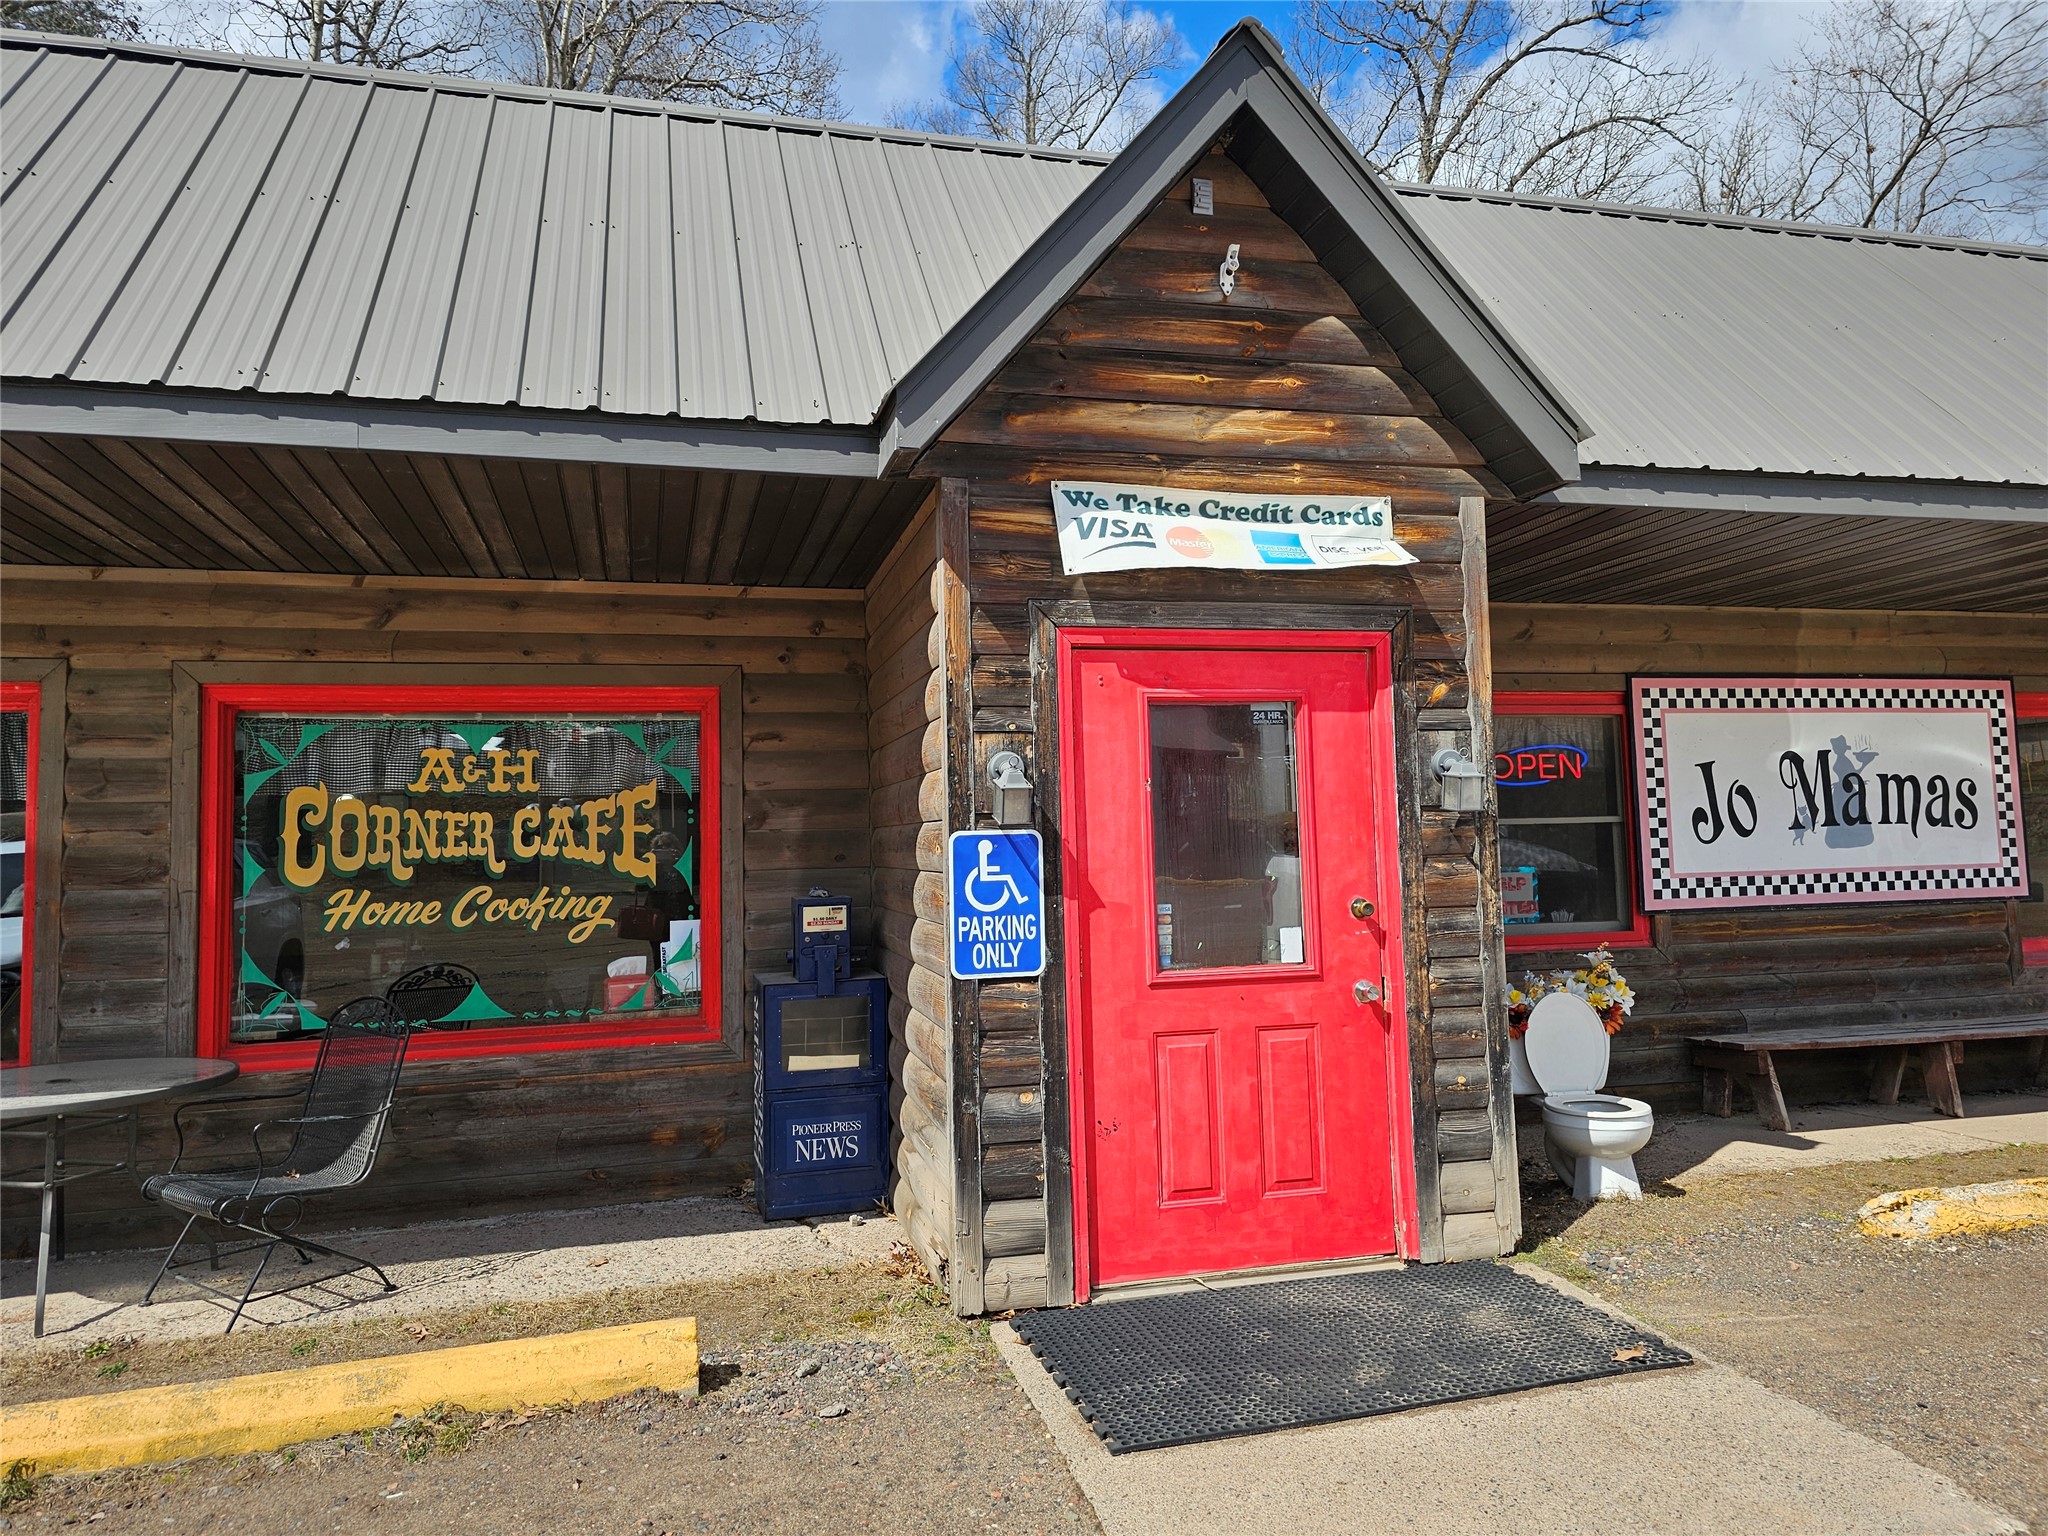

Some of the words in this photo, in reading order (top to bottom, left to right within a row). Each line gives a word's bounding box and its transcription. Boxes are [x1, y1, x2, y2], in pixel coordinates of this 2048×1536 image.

[1061, 490, 1109, 511] We
[1116, 493, 1191, 518] Take
[1198, 499, 1294, 525] Credit
[1300, 504, 1384, 527] Cards
[1070, 516, 1154, 541] VISA
[1318, 544, 1386, 553] DISCVER
[1253, 711, 1266, 720] 24
[1267, 711, 1284, 720] HR.
[407, 747, 541, 794] A&H
[1494, 753, 1583, 780] OPEN
[1692, 760, 1758, 845] Jo
[1778, 749, 1979, 839] Mamas
[280, 781, 506, 888] CORNER
[512, 778, 658, 886] CAFE
[1501, 876, 1527, 891] ELP
[323, 888, 442, 933] Home
[450, 885, 616, 944] Cooking
[958, 914, 1037, 942] PARKING
[972, 942, 1023, 969] ONLY
[791, 1122, 833, 1136] PIONEER
[833, 1120, 862, 1133] PRESS
[794, 1135, 860, 1163] NEWS
